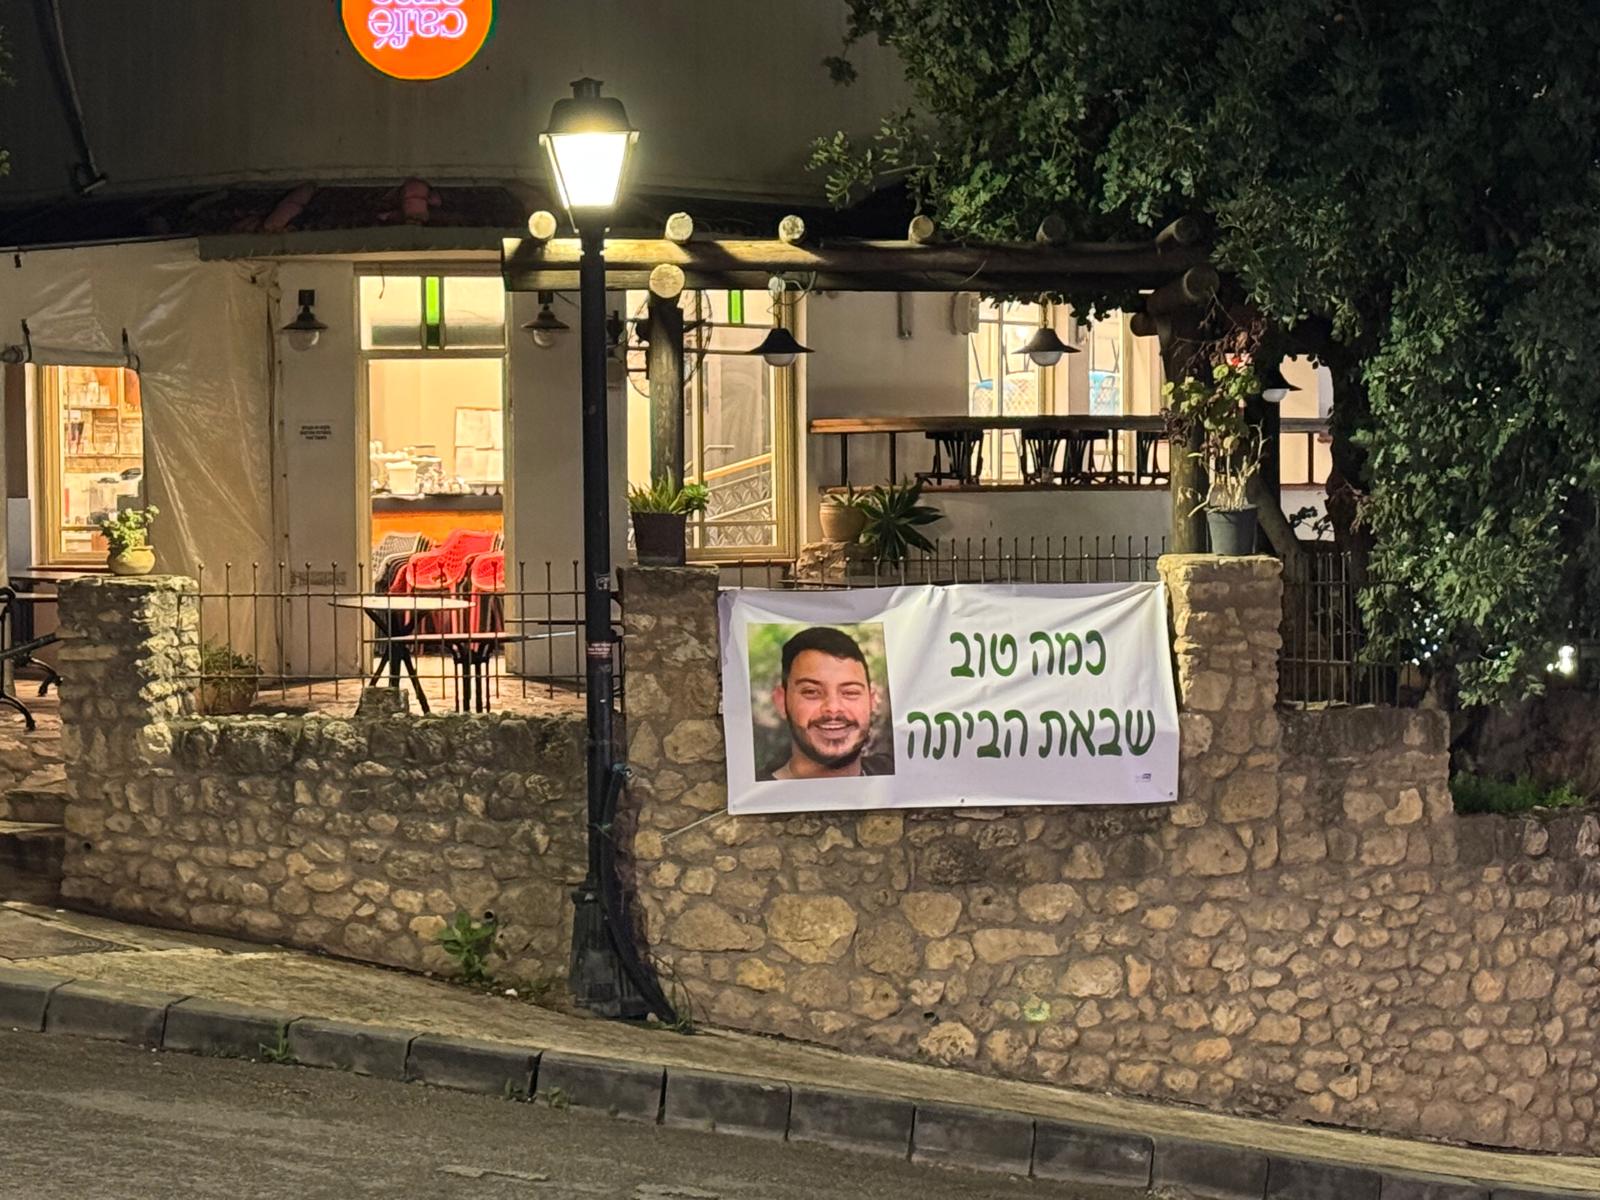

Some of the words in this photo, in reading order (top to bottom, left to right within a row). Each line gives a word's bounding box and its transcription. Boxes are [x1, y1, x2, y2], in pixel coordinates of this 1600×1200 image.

[368, 7, 468, 50] café
[949, 631, 1018, 678] טוב
[1029, 629, 1107, 676] כמה
[907, 708, 1029, 760] הביתה
[1038, 707, 1156, 758] שבאת
